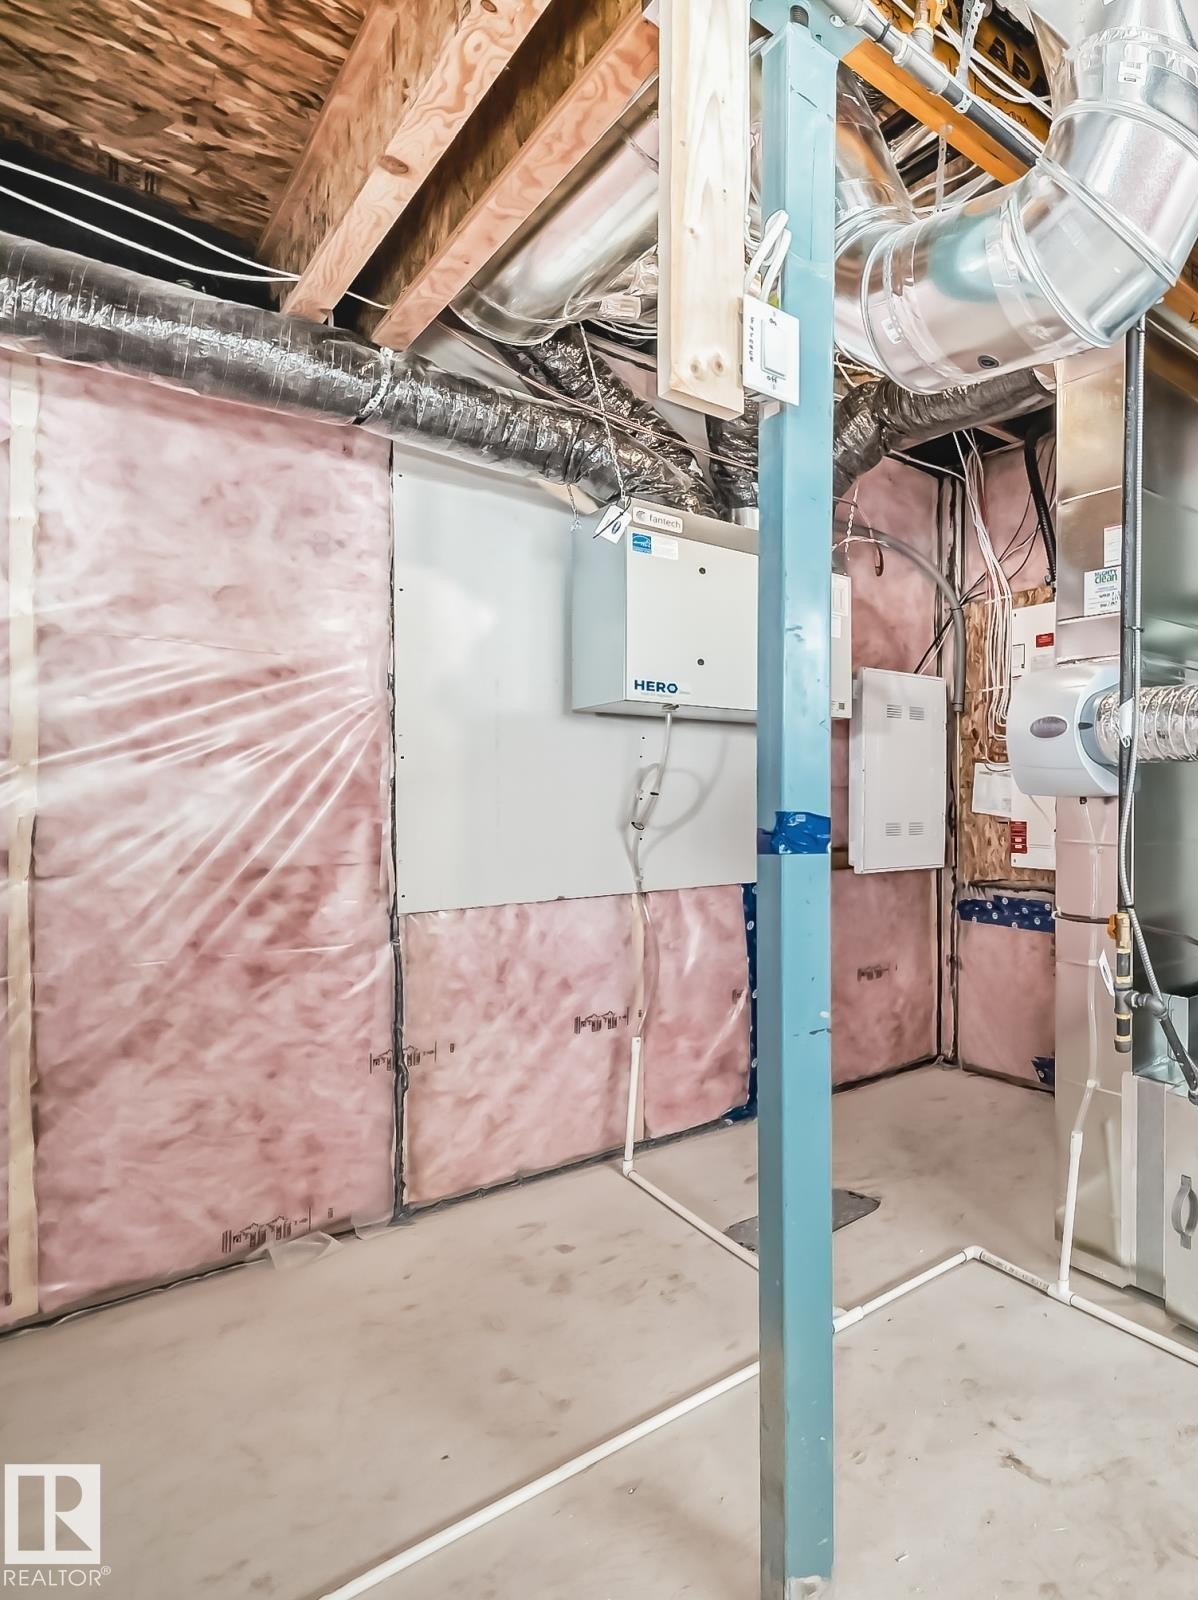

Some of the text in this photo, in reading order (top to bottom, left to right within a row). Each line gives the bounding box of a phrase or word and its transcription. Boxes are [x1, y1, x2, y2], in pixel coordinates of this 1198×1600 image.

[649, 513, 682, 530] fantech
[1094, 573, 1118, 585] clean
[634, 679, 678, 694] HERO
